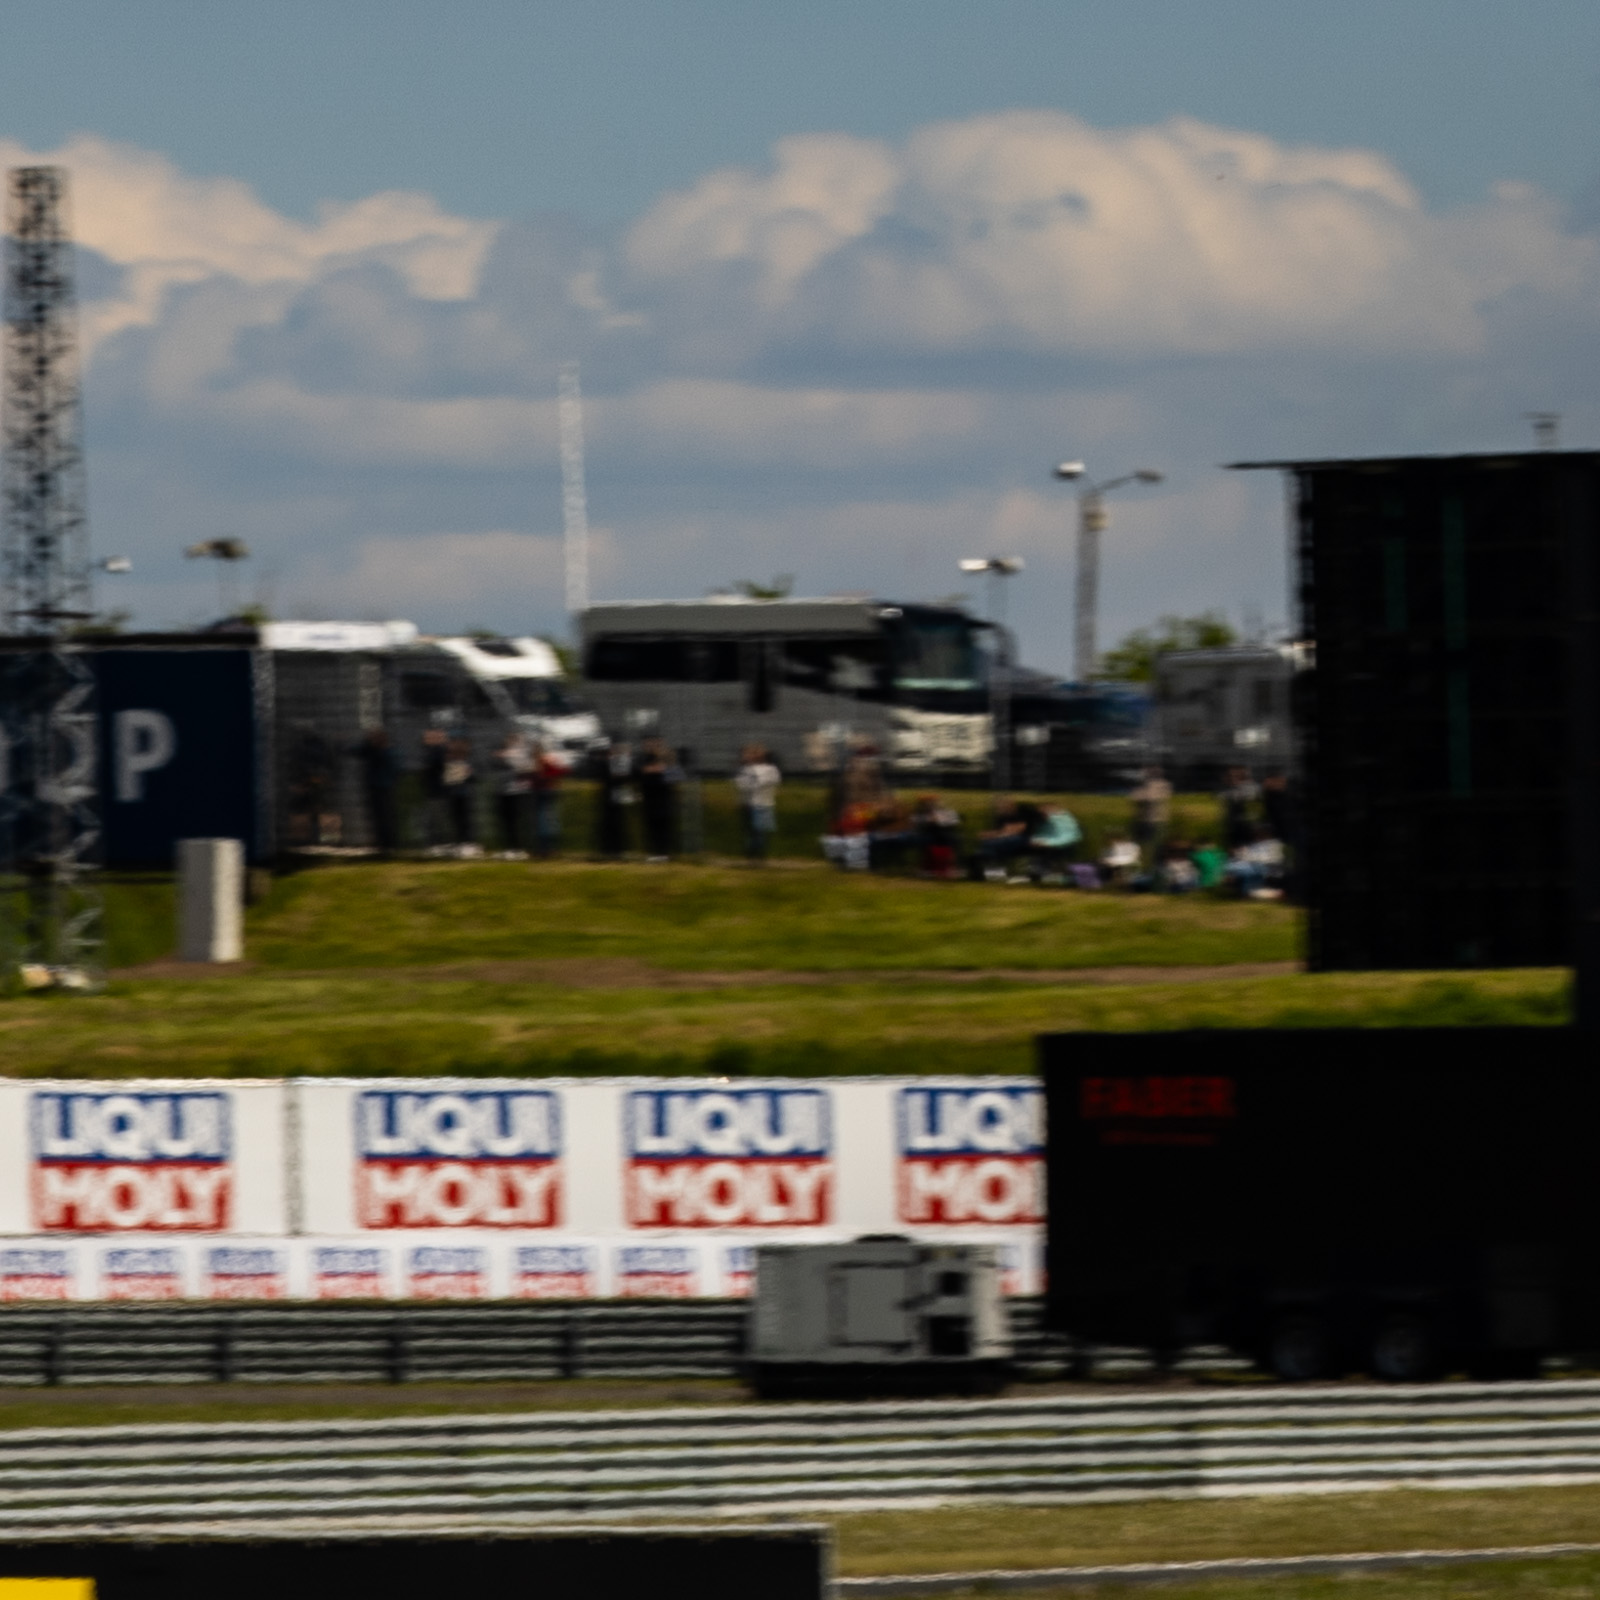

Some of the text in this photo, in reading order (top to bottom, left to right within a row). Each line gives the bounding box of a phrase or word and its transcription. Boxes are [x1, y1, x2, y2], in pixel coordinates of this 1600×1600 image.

[37, 1094, 229, 1157] LIQUI
[362, 1092, 558, 1155] LIQUI
[631, 1091, 827, 1154] LIQUI
[905, 1091, 1047, 1151] LIQU
[37, 1163, 229, 1227] MOLY
[362, 1162, 558, 1225] MOLY
[631, 1161, 827, 1224] MOLY
